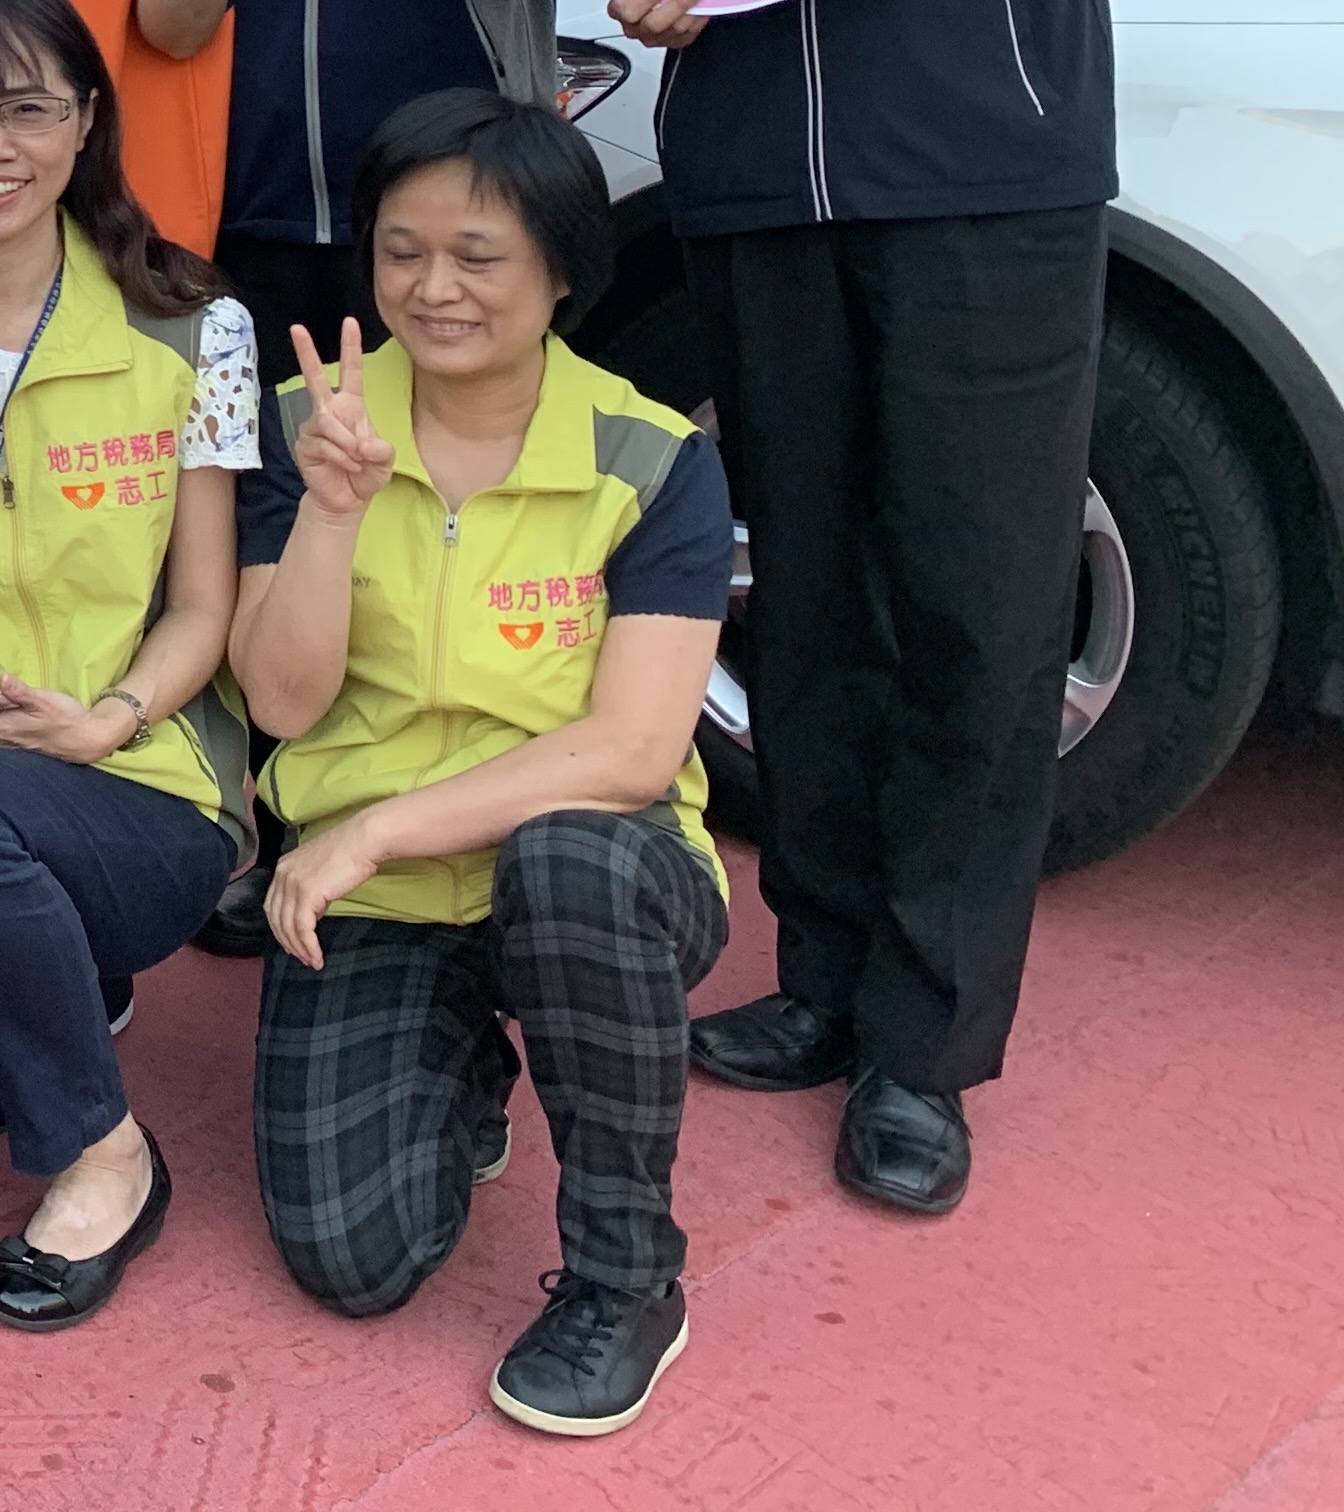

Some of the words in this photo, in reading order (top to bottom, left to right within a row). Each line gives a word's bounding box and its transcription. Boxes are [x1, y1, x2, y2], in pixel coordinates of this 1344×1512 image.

[48, 429, 176, 473] 地方稅務局
[115, 470, 168, 506] 志工
[555, 608, 597, 648] 志工
